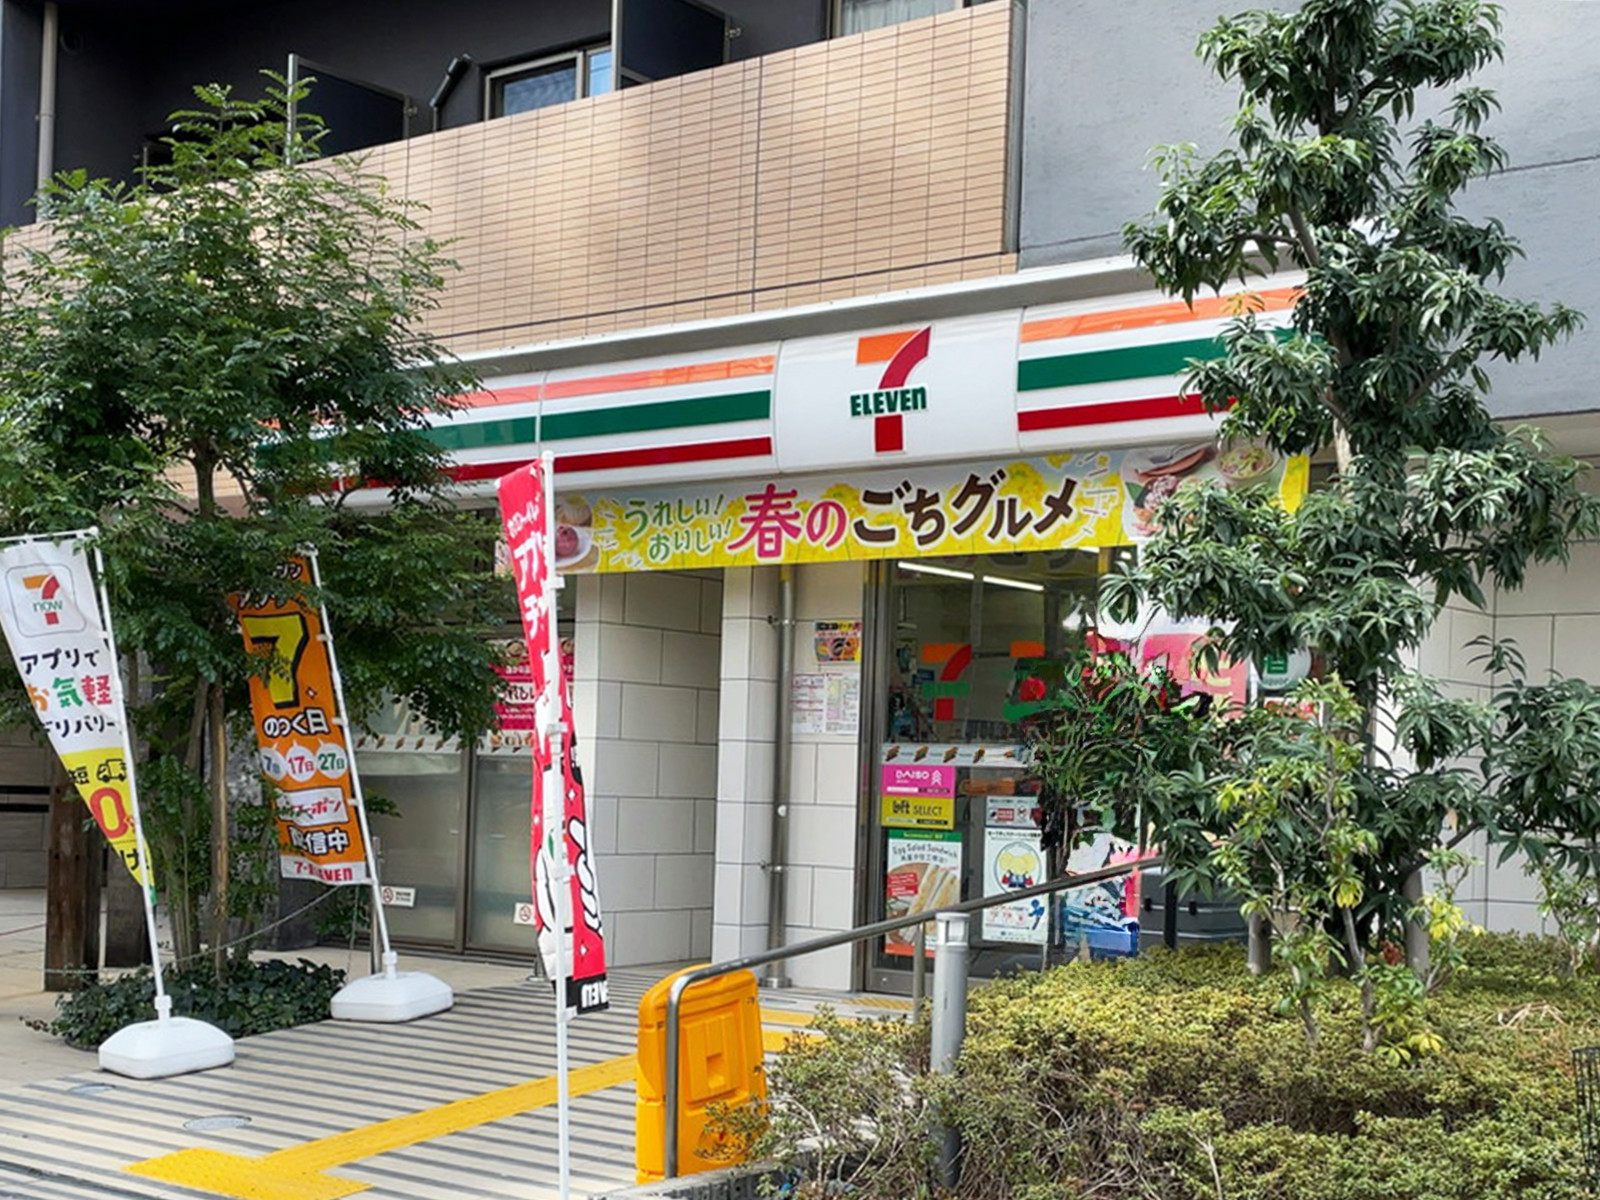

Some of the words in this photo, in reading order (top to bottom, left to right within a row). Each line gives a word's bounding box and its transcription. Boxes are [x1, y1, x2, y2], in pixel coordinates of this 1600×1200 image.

[625, 494, 724, 538] うれしい!
[650, 519, 731, 561] おいしい!
[33, 601, 63, 612] now
[20, 649, 100, 675] アプリで
[242, 613, 309, 709] 7
[288, 756, 314, 775] 17日
[318, 752, 345, 771] 27日
[913, 805, 943, 816] SELECT
